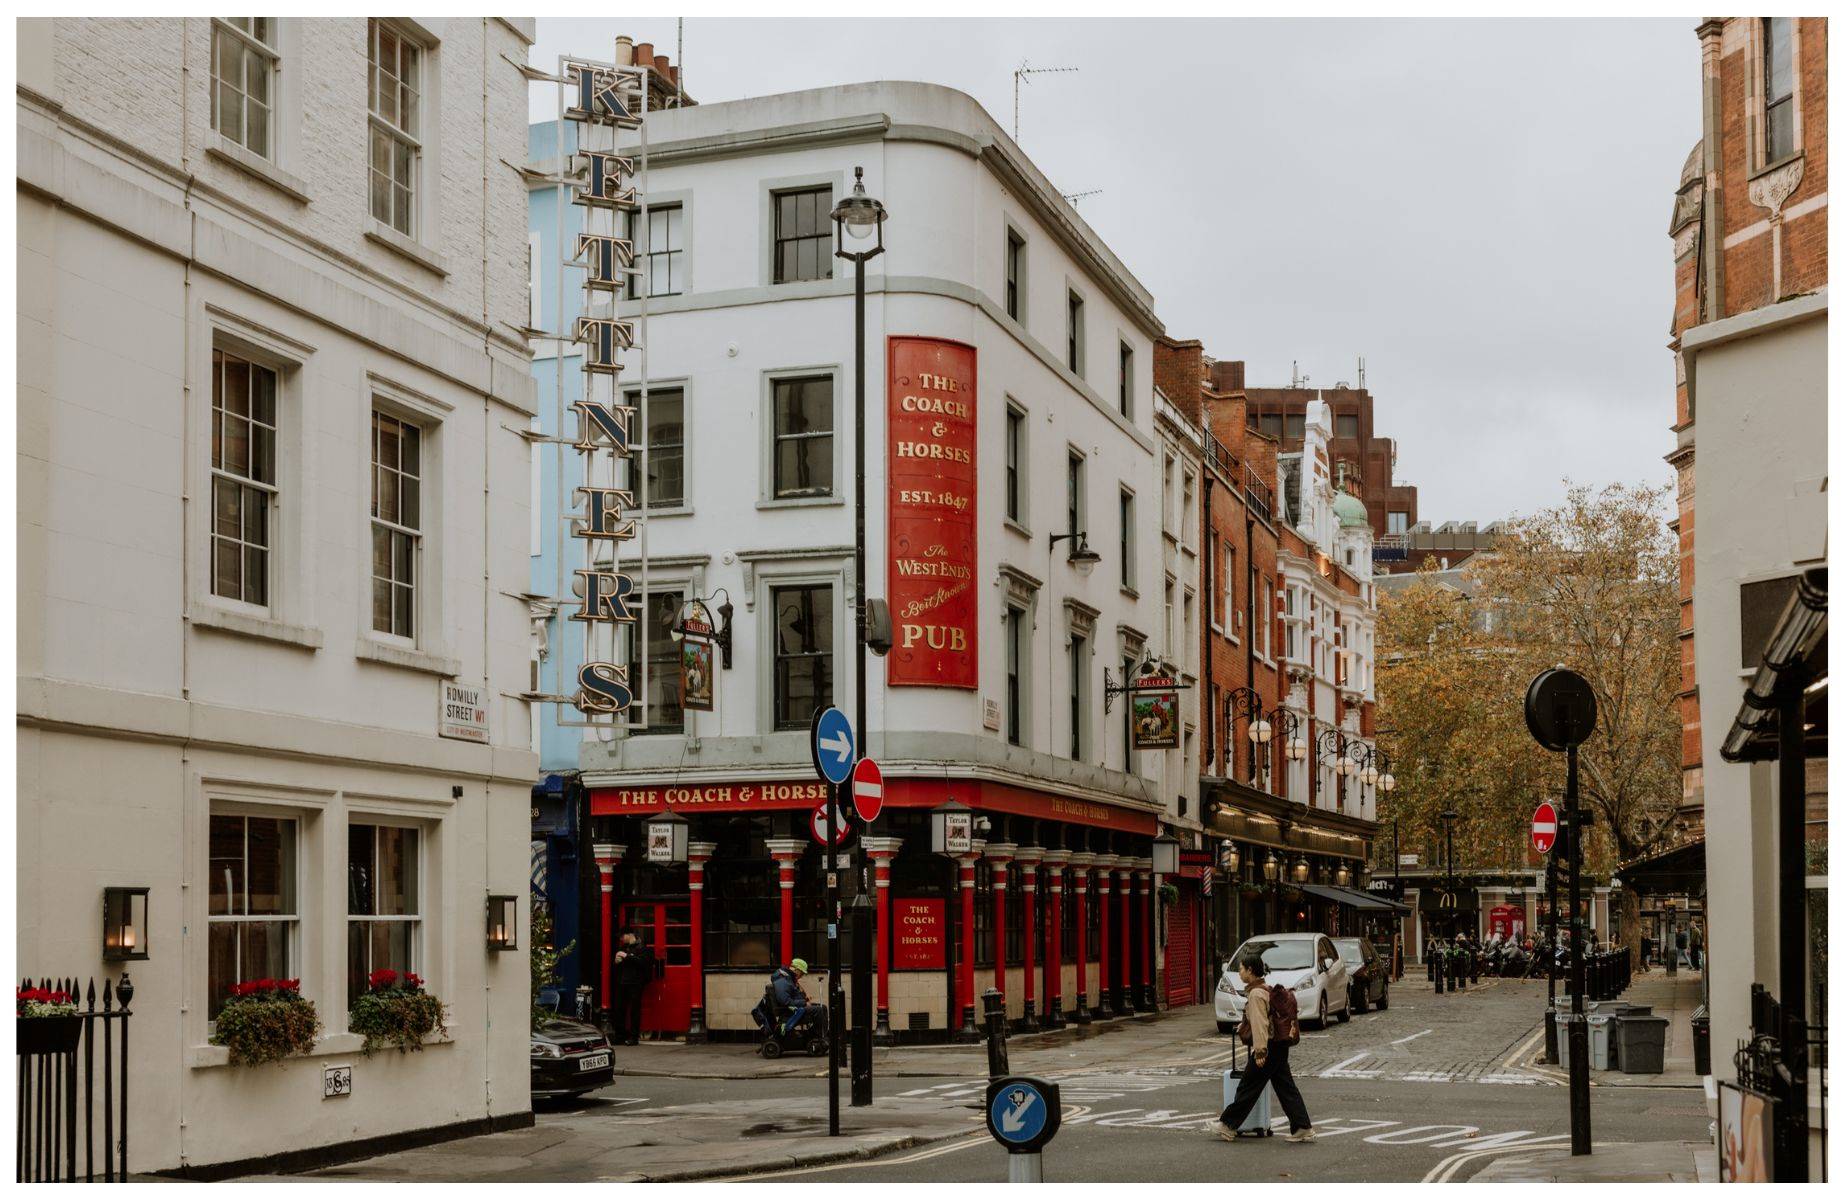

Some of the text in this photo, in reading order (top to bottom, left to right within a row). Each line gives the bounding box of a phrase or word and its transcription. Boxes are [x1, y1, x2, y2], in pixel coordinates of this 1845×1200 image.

[567, 63, 643, 712] KETTNERS
[918, 373, 959, 393] THE
[901, 395, 968, 418] COACH
[931, 421, 948, 437] &
[897, 441, 970, 464] HORSES
[924, 544, 949, 557] The
[901, 596, 933, 618] Best
[901, 624, 967, 651] PUB
[446, 686, 478, 706] ROMILLY
[446, 704, 485, 723] STREET W1
[619, 784, 828, 805] THE COACH & HORSE
[1064, 800, 1083, 816] COACH
[909, 906, 929, 914] THE
[903, 916, 935, 924] COACH
[915, 926, 923, 935] &
[901, 936, 938, 945] HORSES
